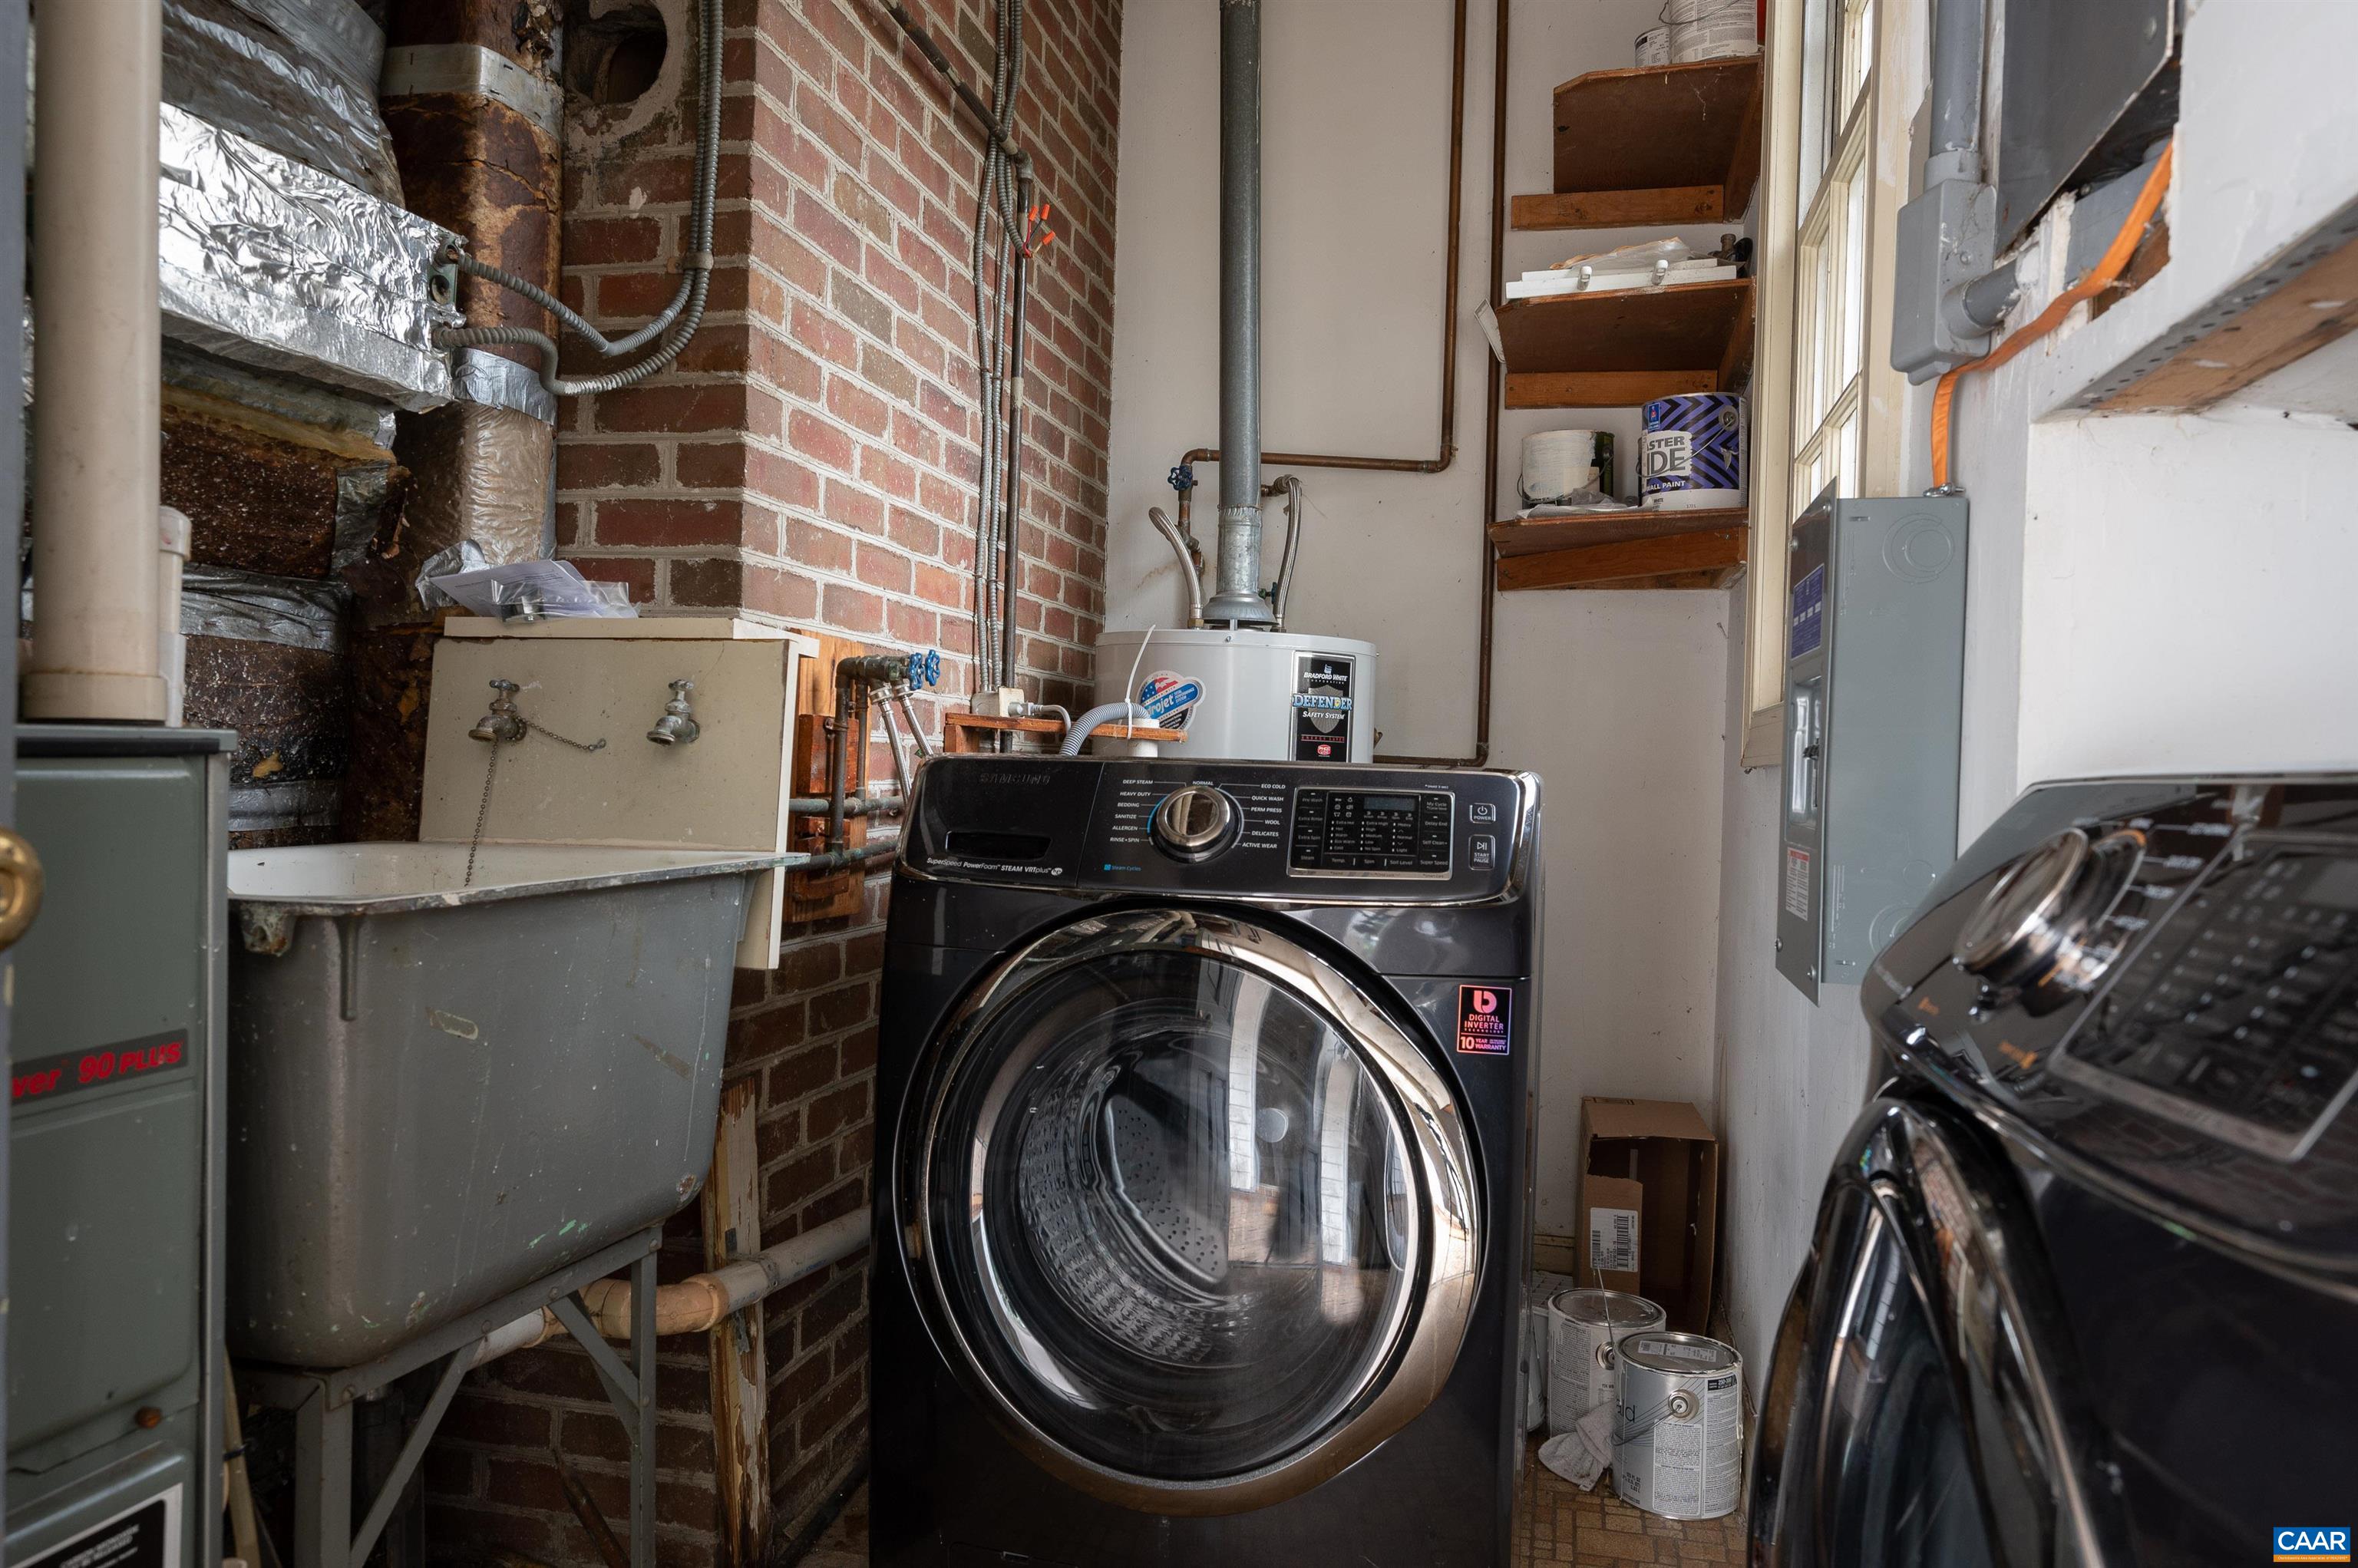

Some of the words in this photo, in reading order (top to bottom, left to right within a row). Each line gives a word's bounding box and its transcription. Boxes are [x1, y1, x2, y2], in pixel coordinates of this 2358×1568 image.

[1647, 436, 1685, 451] STER
[1293, 694, 1352, 710] DEFENDER
[926, 857, 962, 867] SuperSpeed
[1469, 1014, 1500, 1022] DIGITAL
[1465, 1021, 1504, 1030] INVERTER
[1461, 1036, 1475, 1050] 10
[79, 1052, 115, 1084] 90
[119, 1041, 183, 1074] PLUS
